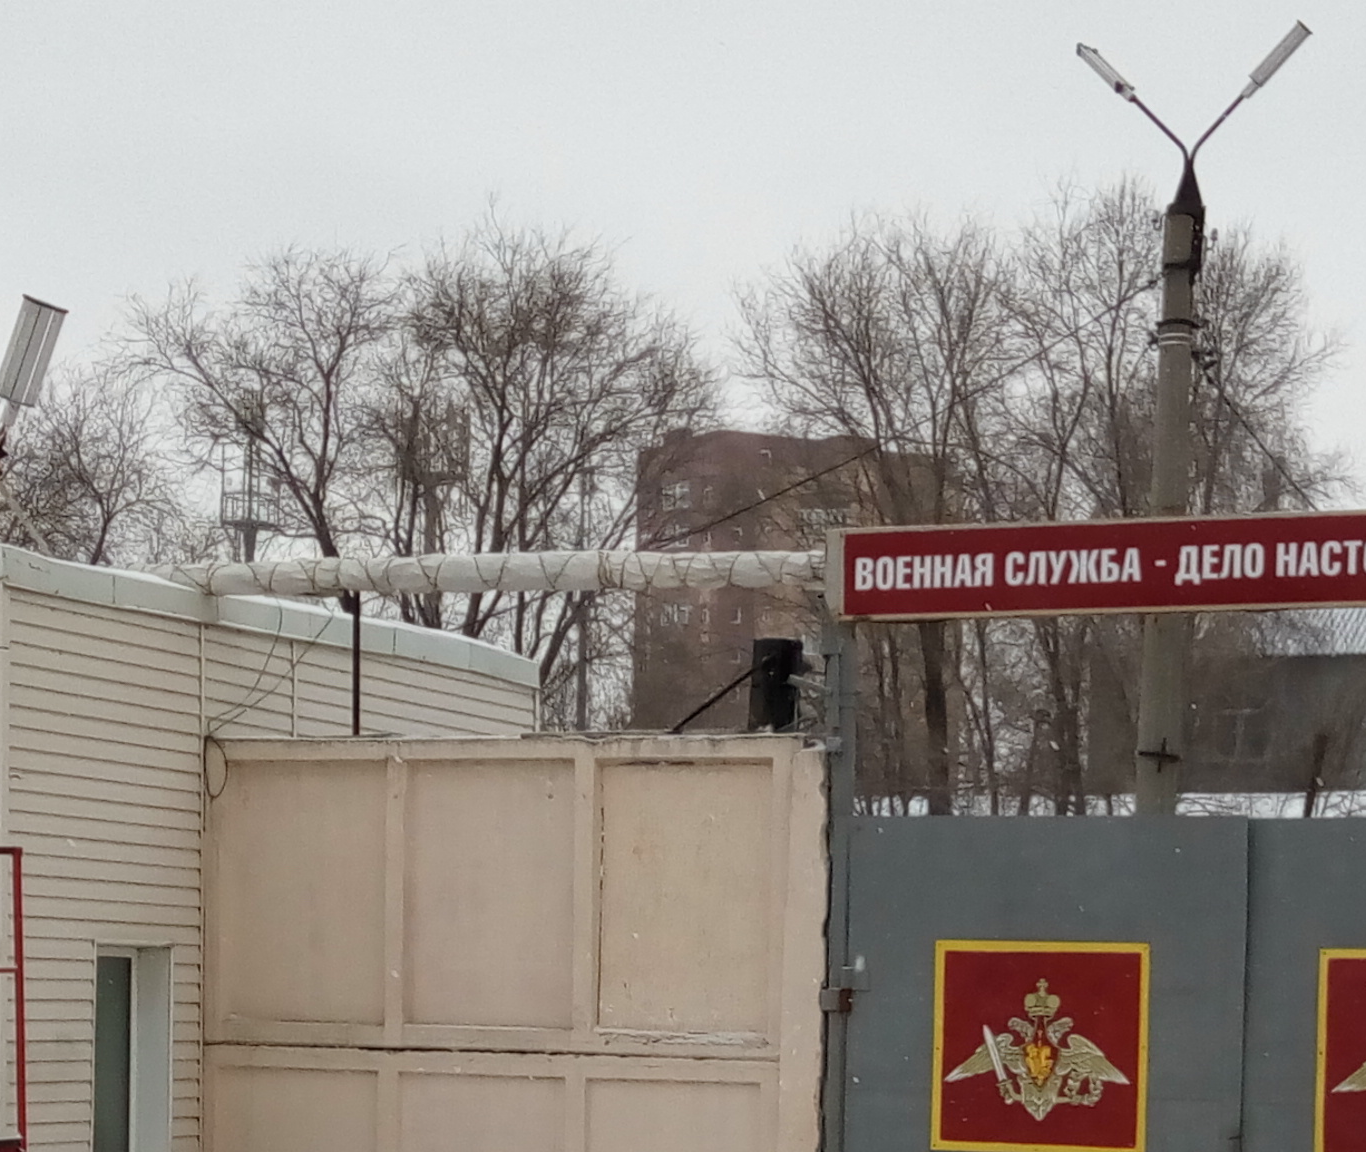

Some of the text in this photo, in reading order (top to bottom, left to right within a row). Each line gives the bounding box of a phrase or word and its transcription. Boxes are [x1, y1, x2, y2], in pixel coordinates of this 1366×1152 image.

[854, 552, 994, 591] ВОЕННАЯ
[1004, 547, 1142, 586] СЛУЖБА
[1174, 542, 1265, 586] ДЕЛО
